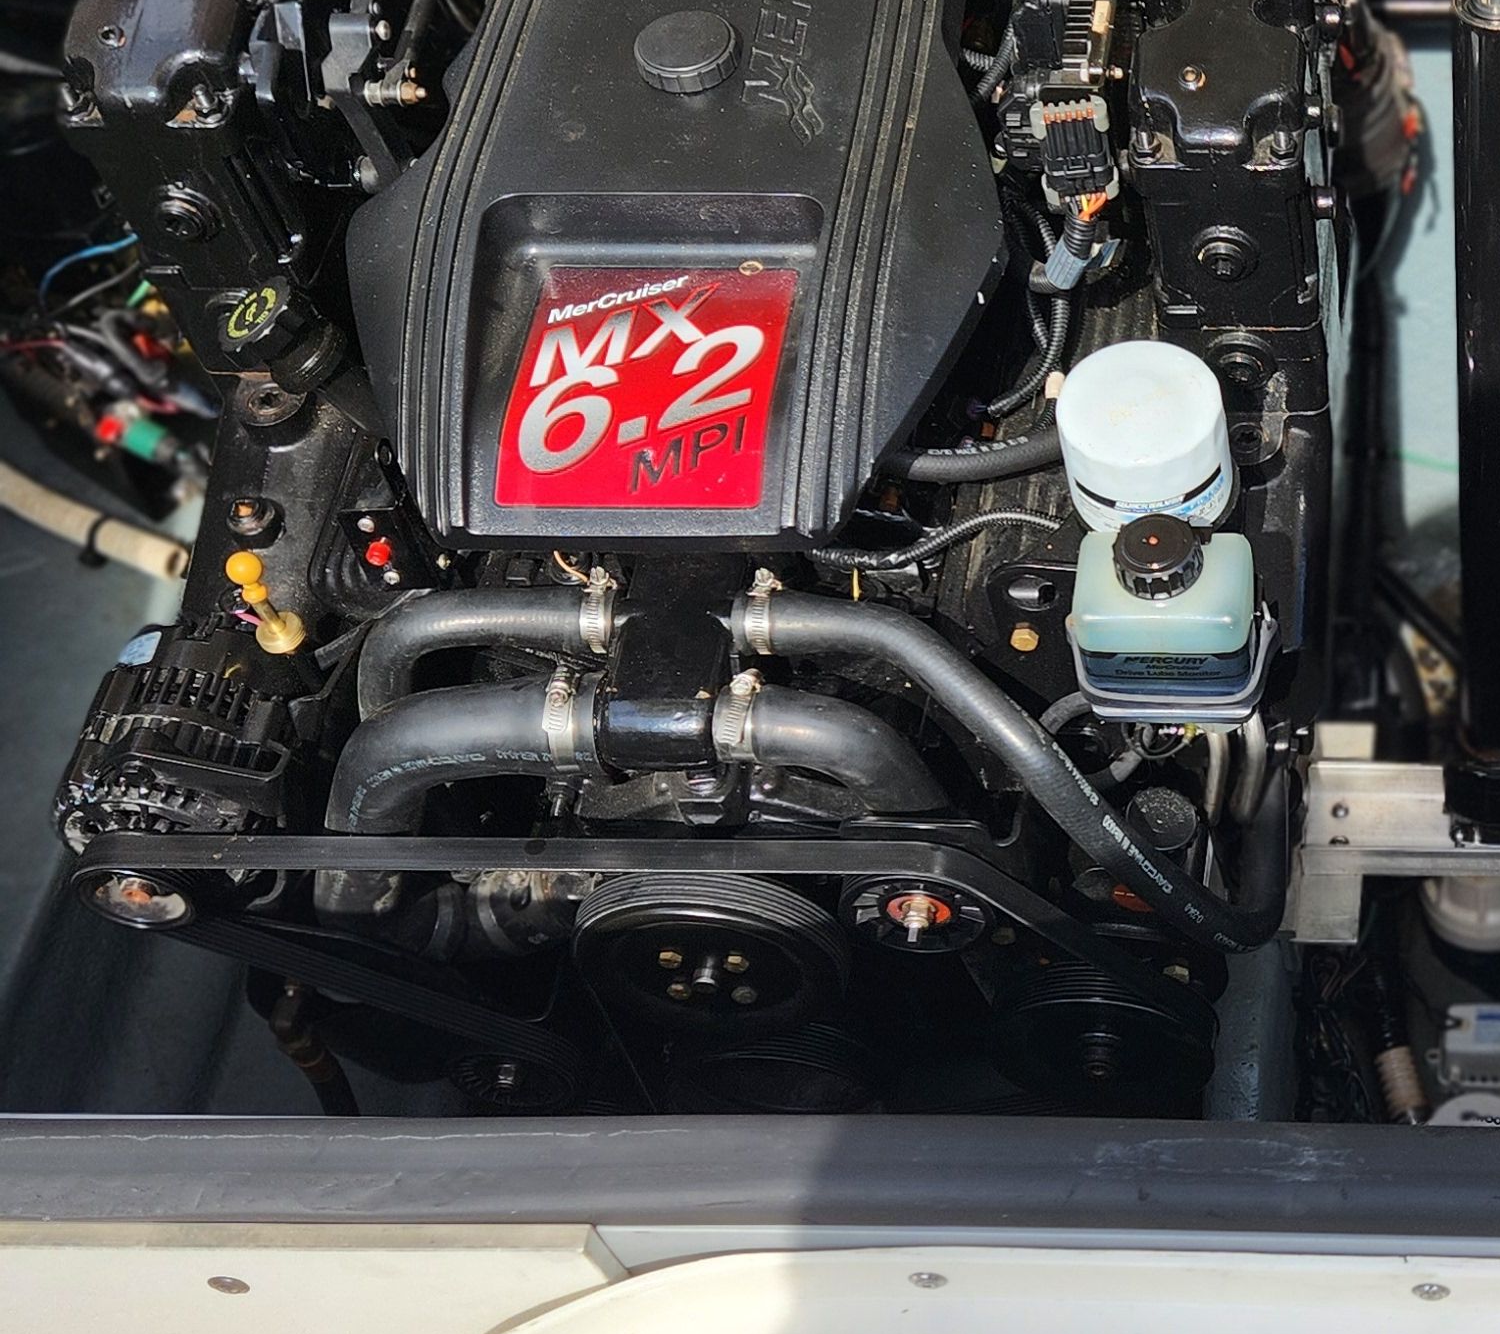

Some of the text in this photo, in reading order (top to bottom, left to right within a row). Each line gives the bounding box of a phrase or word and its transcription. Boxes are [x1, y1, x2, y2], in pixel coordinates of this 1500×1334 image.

[547, 275, 689, 324] MerCruiser
[529, 281, 721, 388] MX
[517, 325, 766, 476] 6.2
[629, 417, 746, 495] MPI
[1115, 669, 1145, 677] Drive
[1123, 657, 1209, 665] MERCURY
